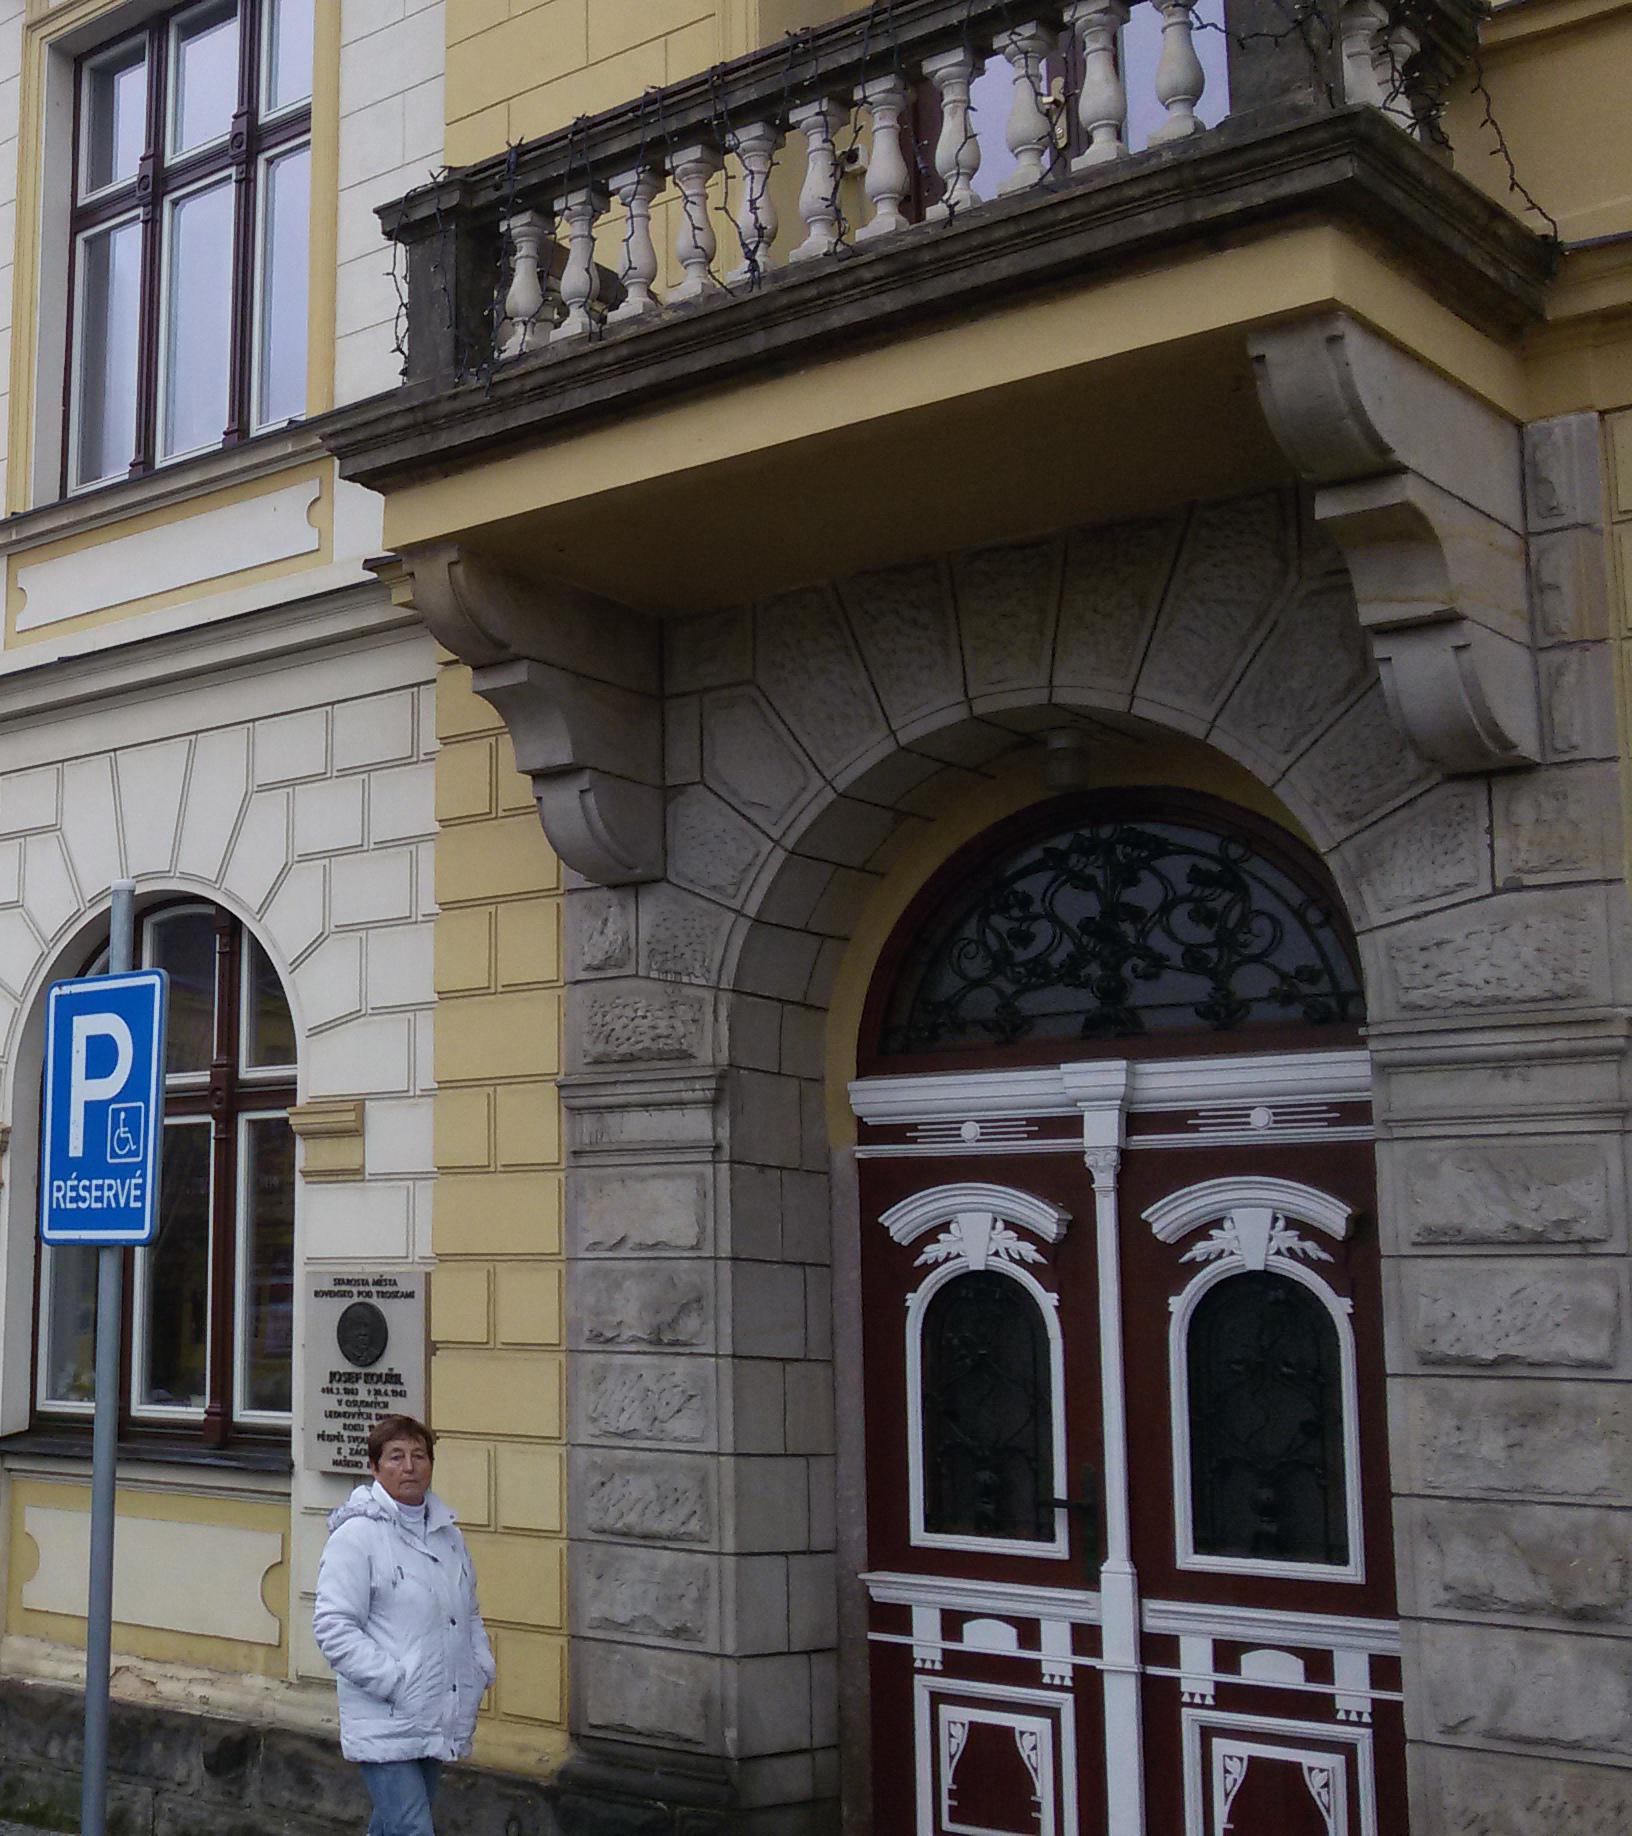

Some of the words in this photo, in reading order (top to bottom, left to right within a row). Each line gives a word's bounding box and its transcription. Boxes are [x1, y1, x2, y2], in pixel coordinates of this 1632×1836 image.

[69, 1012, 133, 1157] P
[52, 1169, 143, 1210] RÉSERVÉ
[333, 1277, 370, 1287] STAROSTA
[372, 1274, 398, 1287] MĚSTA
[314, 1289, 354, 1299] ROVENSKO
[357, 1289, 374, 1299] POD
[376, 1290, 415, 1300] TROSKAMI
[329, 1370, 363, 1385] JOSEF
